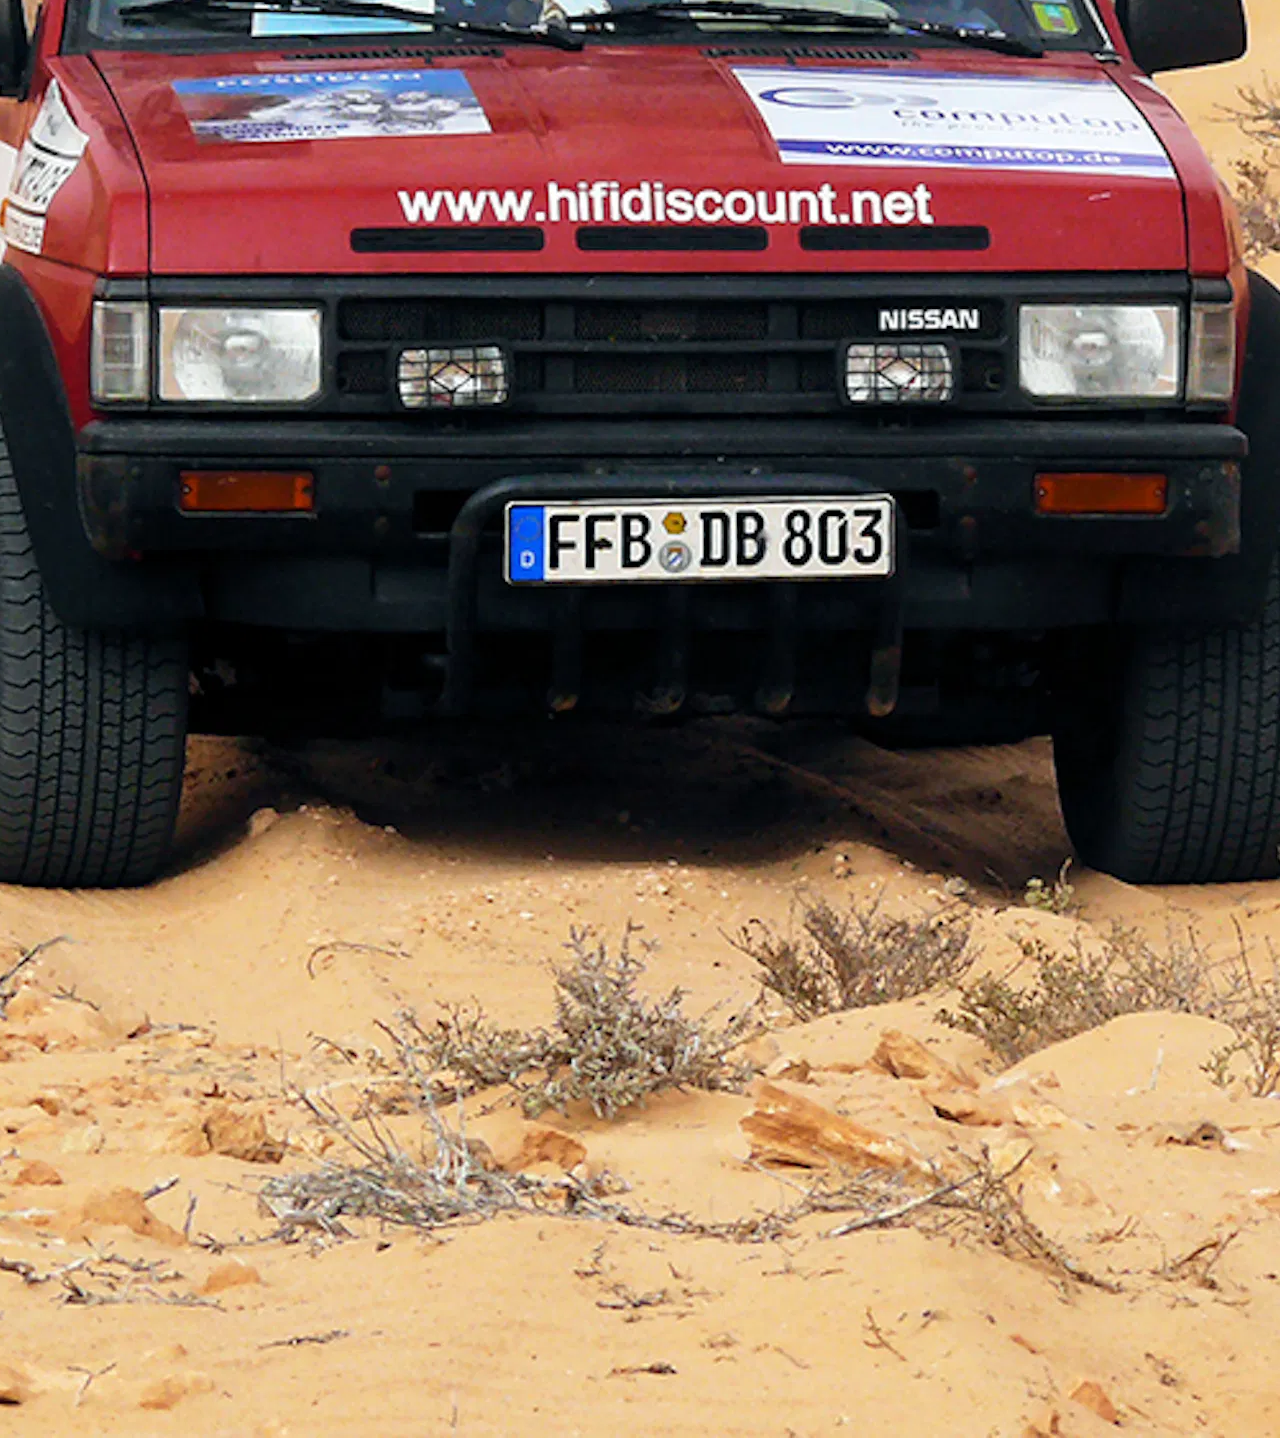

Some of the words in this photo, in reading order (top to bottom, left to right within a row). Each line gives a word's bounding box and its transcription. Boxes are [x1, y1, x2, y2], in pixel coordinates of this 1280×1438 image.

[892, 108, 1140, 133] computop
[825, 142, 1122, 165] www.computop.de
[397, 181, 934, 224] www.hifidiscount.net
[879, 308, 980, 331] NISSAN
[549, 512, 652, 570] FFB
[699, 510, 766, 568] DB
[782, 508, 883, 566] 803
